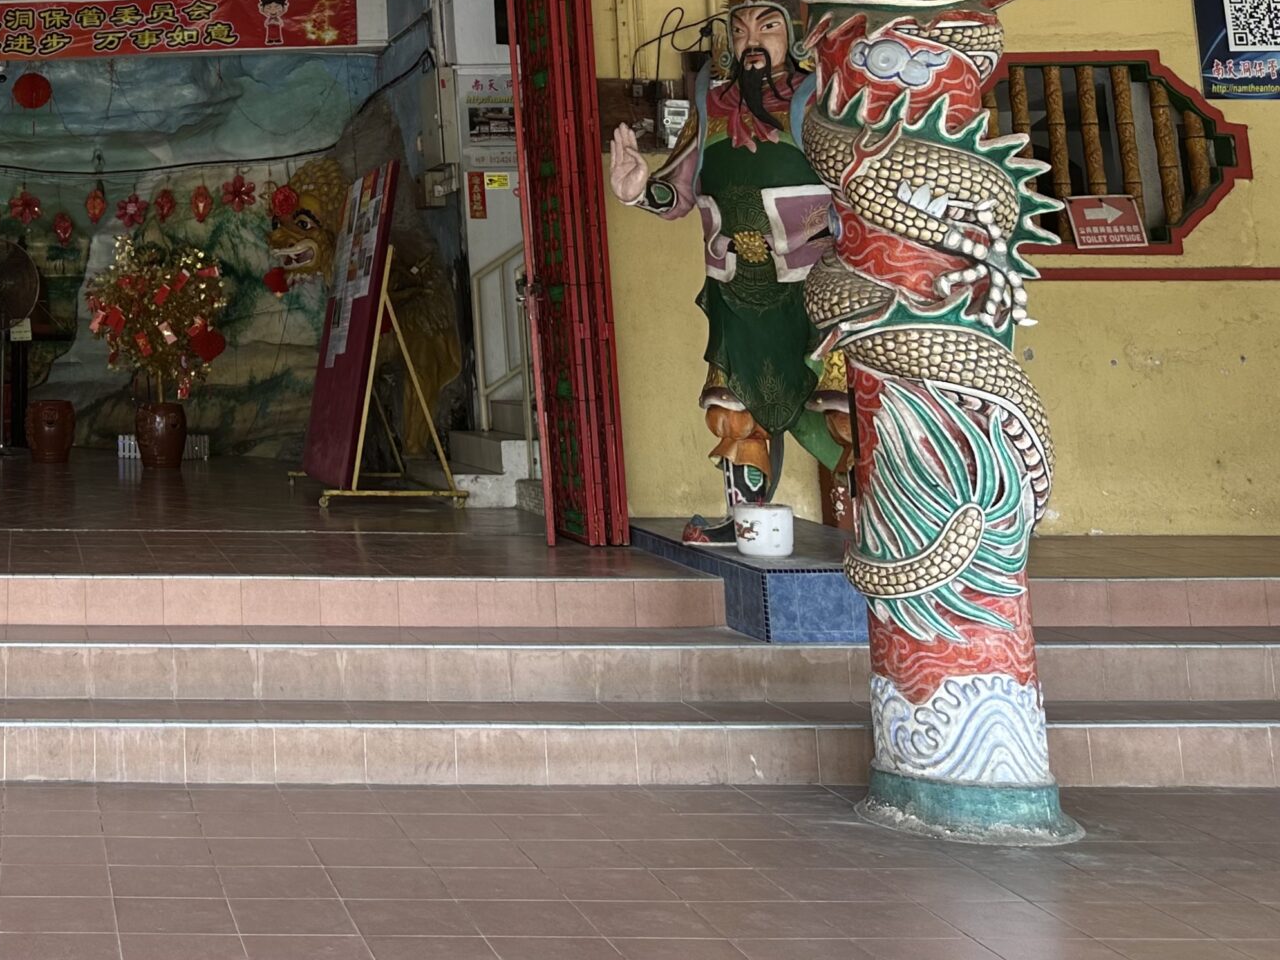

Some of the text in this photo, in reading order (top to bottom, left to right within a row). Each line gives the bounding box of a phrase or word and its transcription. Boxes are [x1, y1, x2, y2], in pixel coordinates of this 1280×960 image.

[92, 22, 238, 51] 万事如意
[1080, 233, 1142, 243] TOILET OUTSIDE
